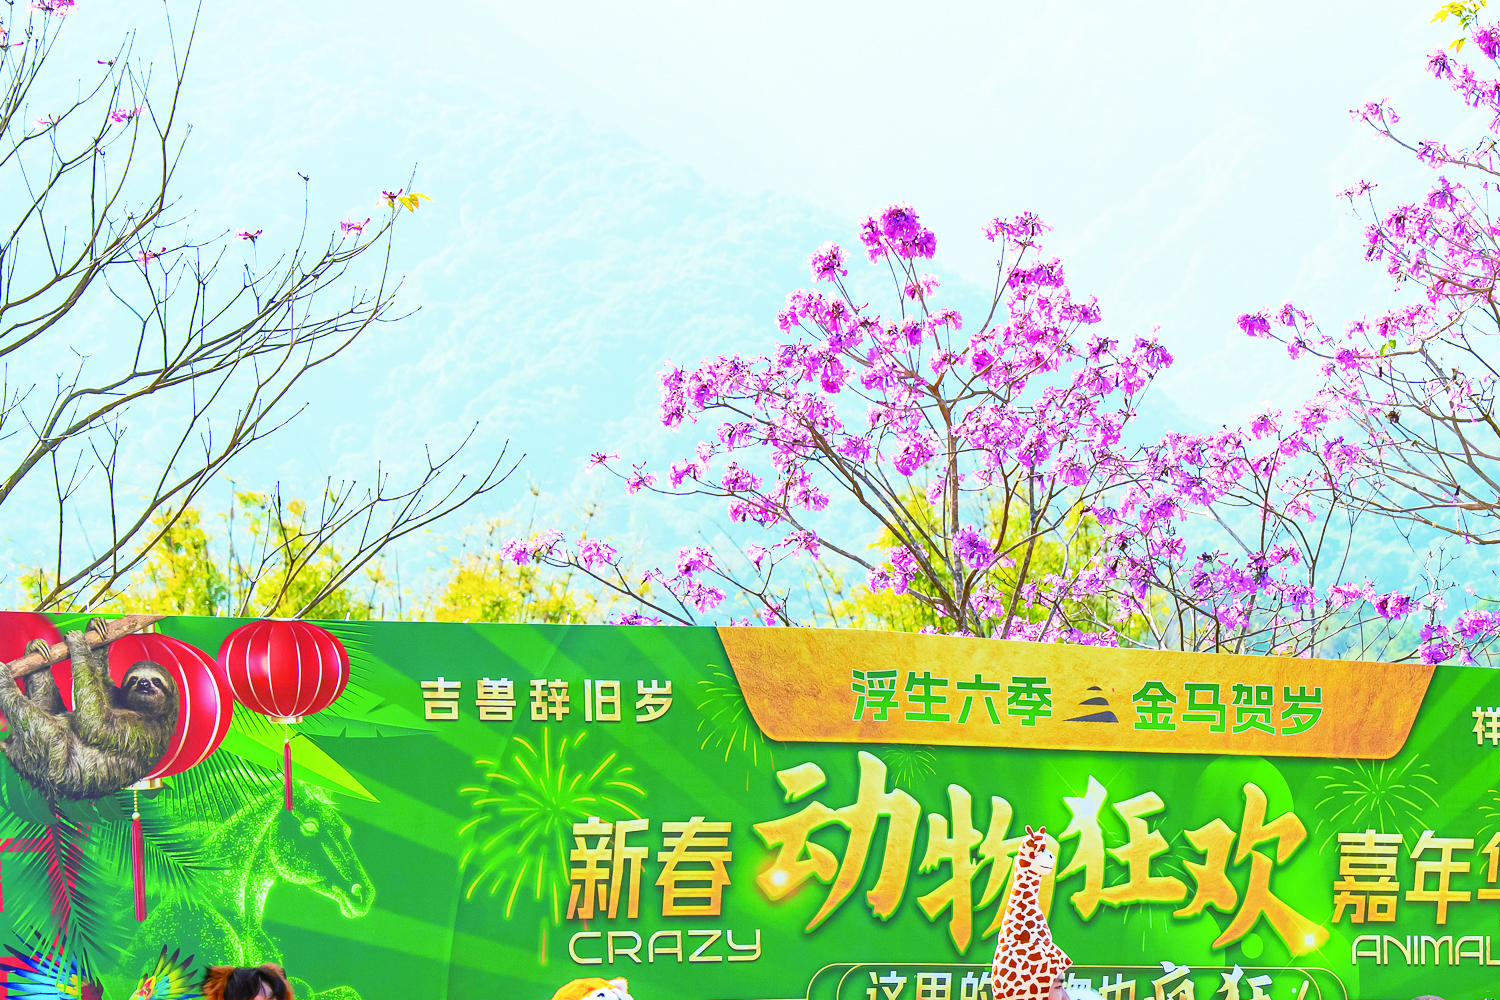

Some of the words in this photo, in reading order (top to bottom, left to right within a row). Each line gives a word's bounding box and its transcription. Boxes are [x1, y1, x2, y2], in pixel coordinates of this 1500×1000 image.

[421, 676, 674, 723] 吉兽辞旧岁
[851, 668, 1054, 727] 浮生六季
[1131, 680, 1324, 736] 金马贺岁
[566, 816, 732, 920] 新春
[753, 750, 1330, 957] 动物狂欢
[568, 928, 762, 965] CRAZY
